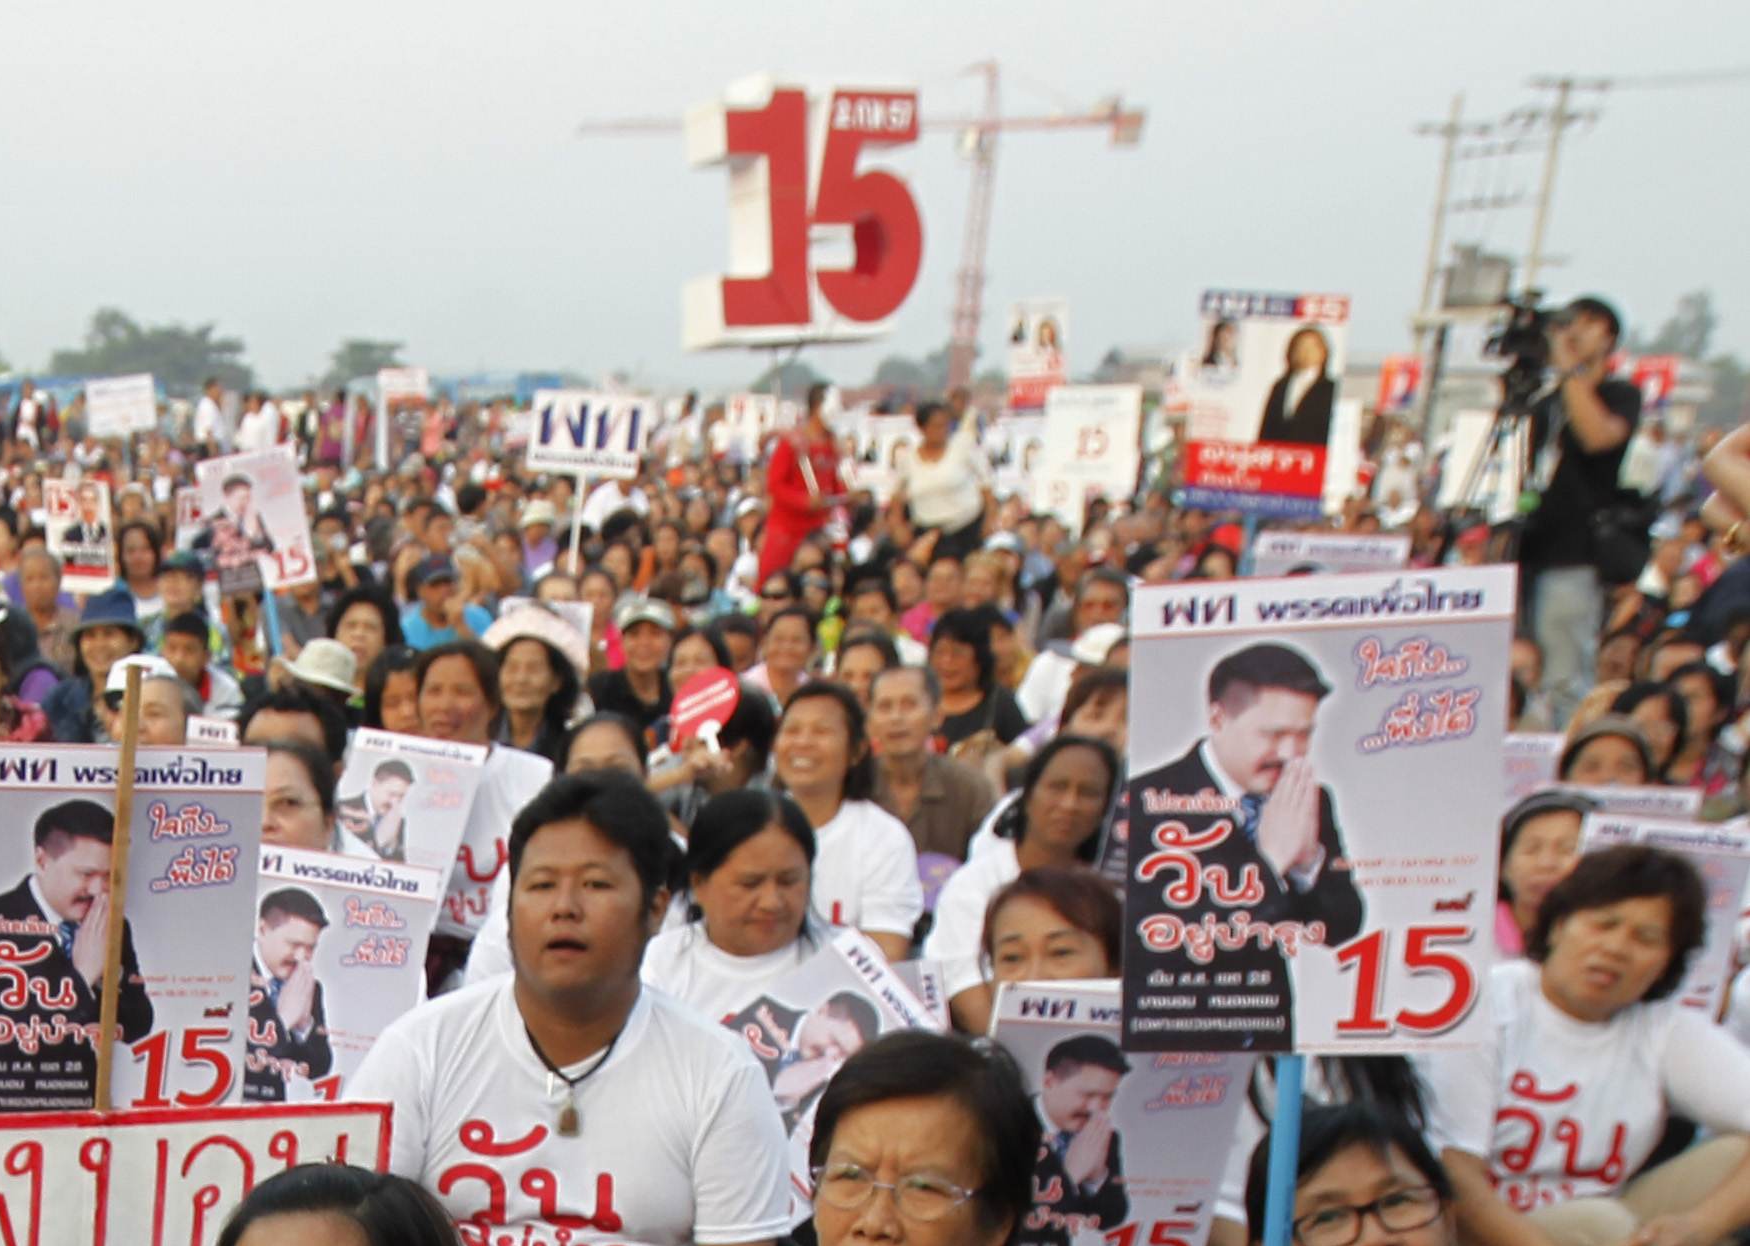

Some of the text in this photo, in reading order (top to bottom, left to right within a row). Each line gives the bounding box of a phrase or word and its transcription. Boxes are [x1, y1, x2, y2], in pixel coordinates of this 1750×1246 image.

[720, 89, 922, 324] 15
[540, 403, 641, 452] พท
[273, 548, 310, 580] 15
[1161, 577, 1484, 627] พท พรรคเพื่อไทย
[73, 754, 243, 786] พรคเพื่อไทย
[262, 855, 419, 893] ท พรรคเพื่อไทย
[1135, 819, 1265, 908] วัน
[1136, 910, 1327, 965] อยู่บำรุง
[1336, 926, 1476, 1033] 15
[1020, 996, 1077, 1019] พท
[131, 1028, 234, 1109] 15
[1497, 1070, 1626, 1184] วัน
[438, 1118, 623, 1232] วัน
